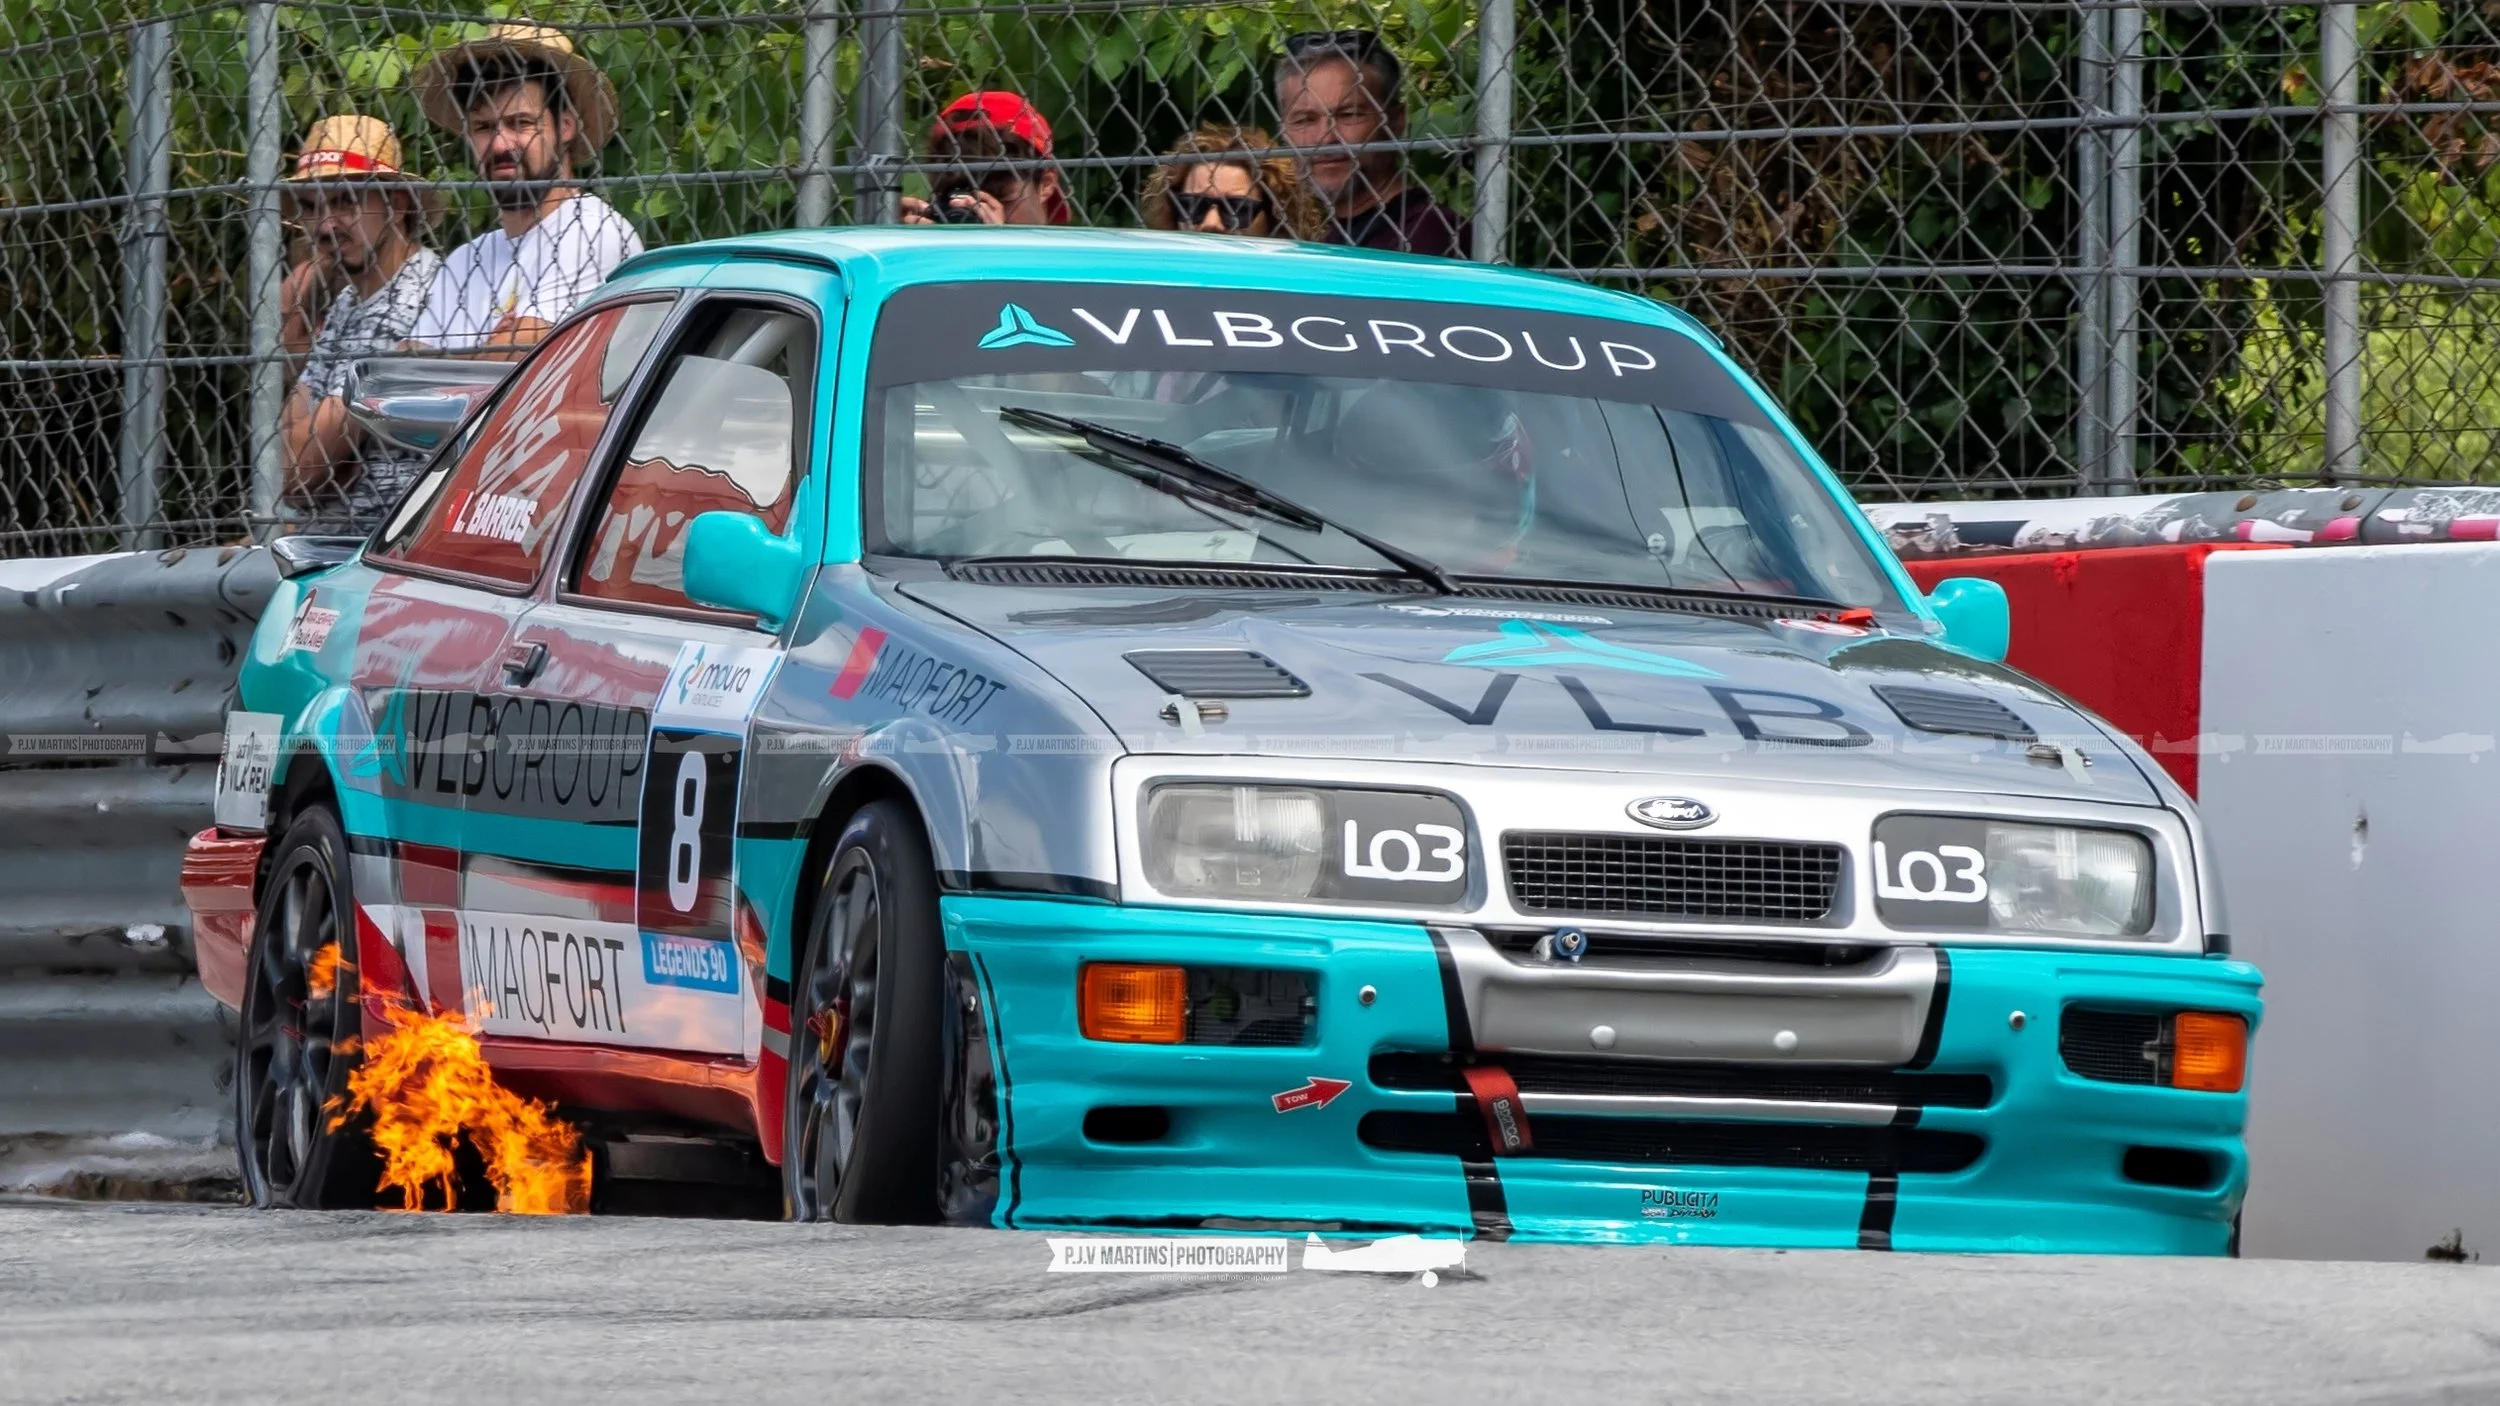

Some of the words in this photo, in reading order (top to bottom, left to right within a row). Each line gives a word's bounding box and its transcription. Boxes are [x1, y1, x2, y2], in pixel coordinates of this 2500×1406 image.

[1071, 307, 1656, 378] VLBGROUP
[466, 492, 539, 543] BARROS
[697, 663, 751, 693] moura
[861, 644, 1007, 726] MAQFORT
[1356, 672, 1876, 743] VLB
[412, 686, 649, 811] VLBGROUP
[668, 751, 708, 912] 8
[470, 924, 627, 1036] MAQFORT
[651, 940, 709, 981] LEGENDS
[710, 947, 727, 983] 90
[1284, 1093, 1309, 1105] TOW
